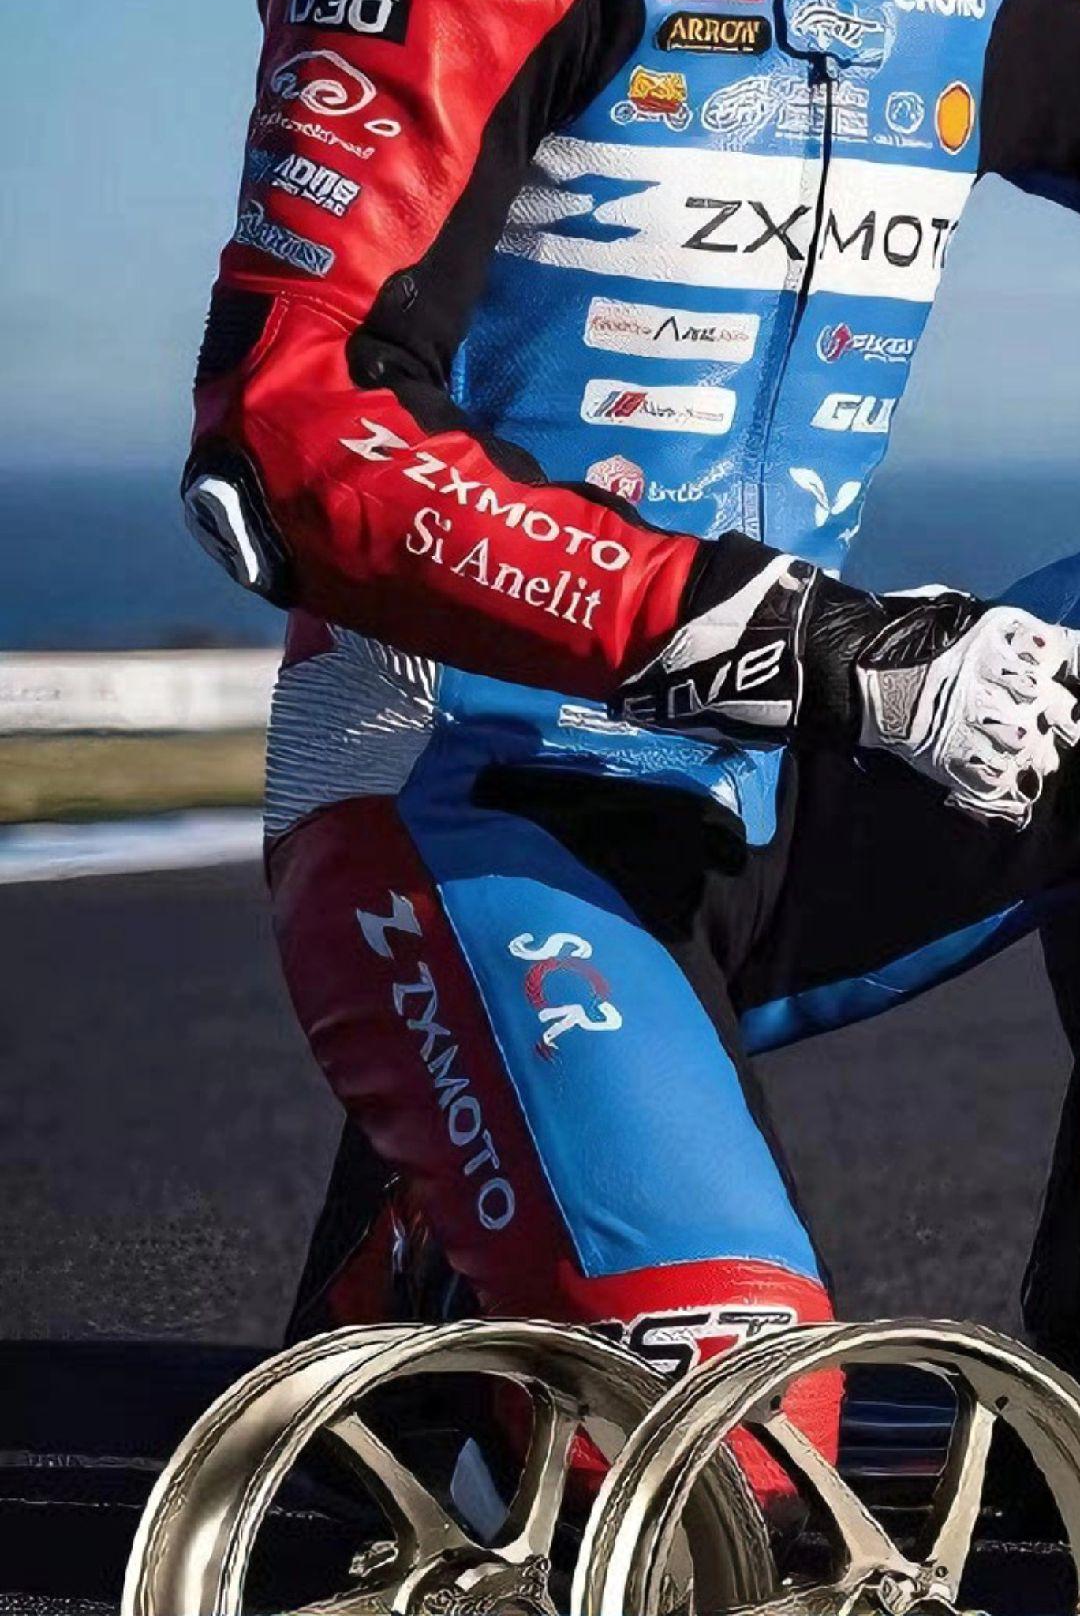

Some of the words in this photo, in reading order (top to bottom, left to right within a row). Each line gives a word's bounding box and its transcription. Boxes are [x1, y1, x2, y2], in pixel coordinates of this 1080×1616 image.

[669, 17, 761, 44] ARROW
[680, 196, 959, 269] ZXMOT
[402, 451, 632, 571] ZXMOTO
[392, 961, 516, 1231] ZXMOTO
